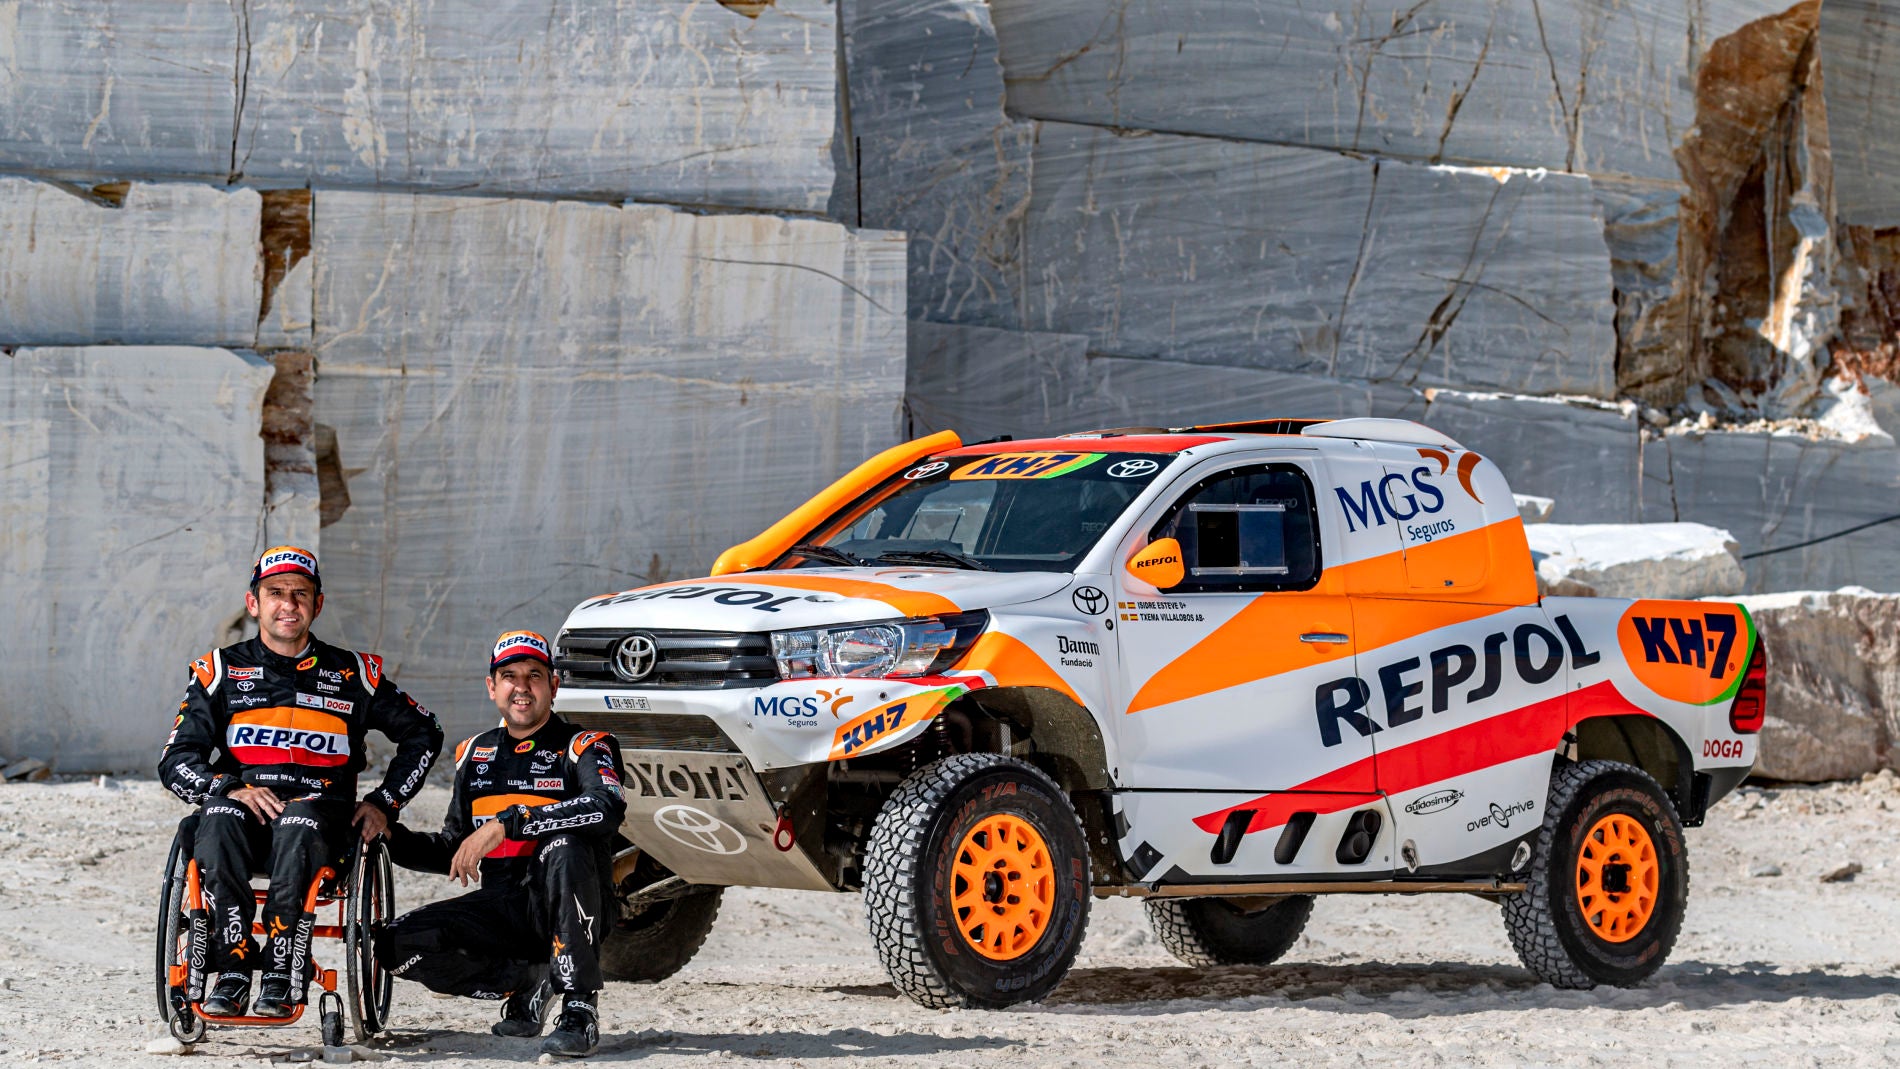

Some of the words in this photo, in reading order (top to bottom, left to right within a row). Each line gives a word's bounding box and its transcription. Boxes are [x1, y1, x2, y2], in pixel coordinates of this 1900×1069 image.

[965, 454, 1081, 477] KH-7
[1335, 467, 1444, 532] MGS
[1407, 518, 1455, 542] Seguros
[265, 553, 313, 569] REPSOL
[1137, 556, 1178, 568] REPSOL
[581, 586, 801, 613] REPSOL
[1137, 601, 1156, 609] ISIDRE
[1157, 601, 1179, 609] ESTEVE
[1140, 613, 1160, 621] TXEMA
[1161, 613, 1195, 622] VILLALOBOS
[498, 636, 545, 651] REPSOL
[1057, 635, 1101, 656] Damm
[1632, 613, 1737, 680] KH-7
[1060, 656, 1093, 669] Fundació
[319, 668, 342, 680] MGS
[1316, 614, 1600, 747] REPSOL
[317, 682, 340, 692] Damm
[326, 701, 351, 712] DOGA
[754, 696, 818, 717] MGS
[787, 718, 818, 728] Seguros
[842, 702, 907, 755] KH-7
[234, 727, 338, 753] REPSOL
[1704, 739, 1743, 759] DOGA
[399, 749, 434, 797] REPSOL
[622, 763, 748, 801] OYOTA
[1404, 790, 1465, 814] Guidosimplex
[206, 806, 246, 820] REPSOL
[280, 816, 320, 830] REPSOL
[228, 905, 242, 944] MGS
[274, 936, 287, 970] MGS
[558, 955, 575, 990] MGS
